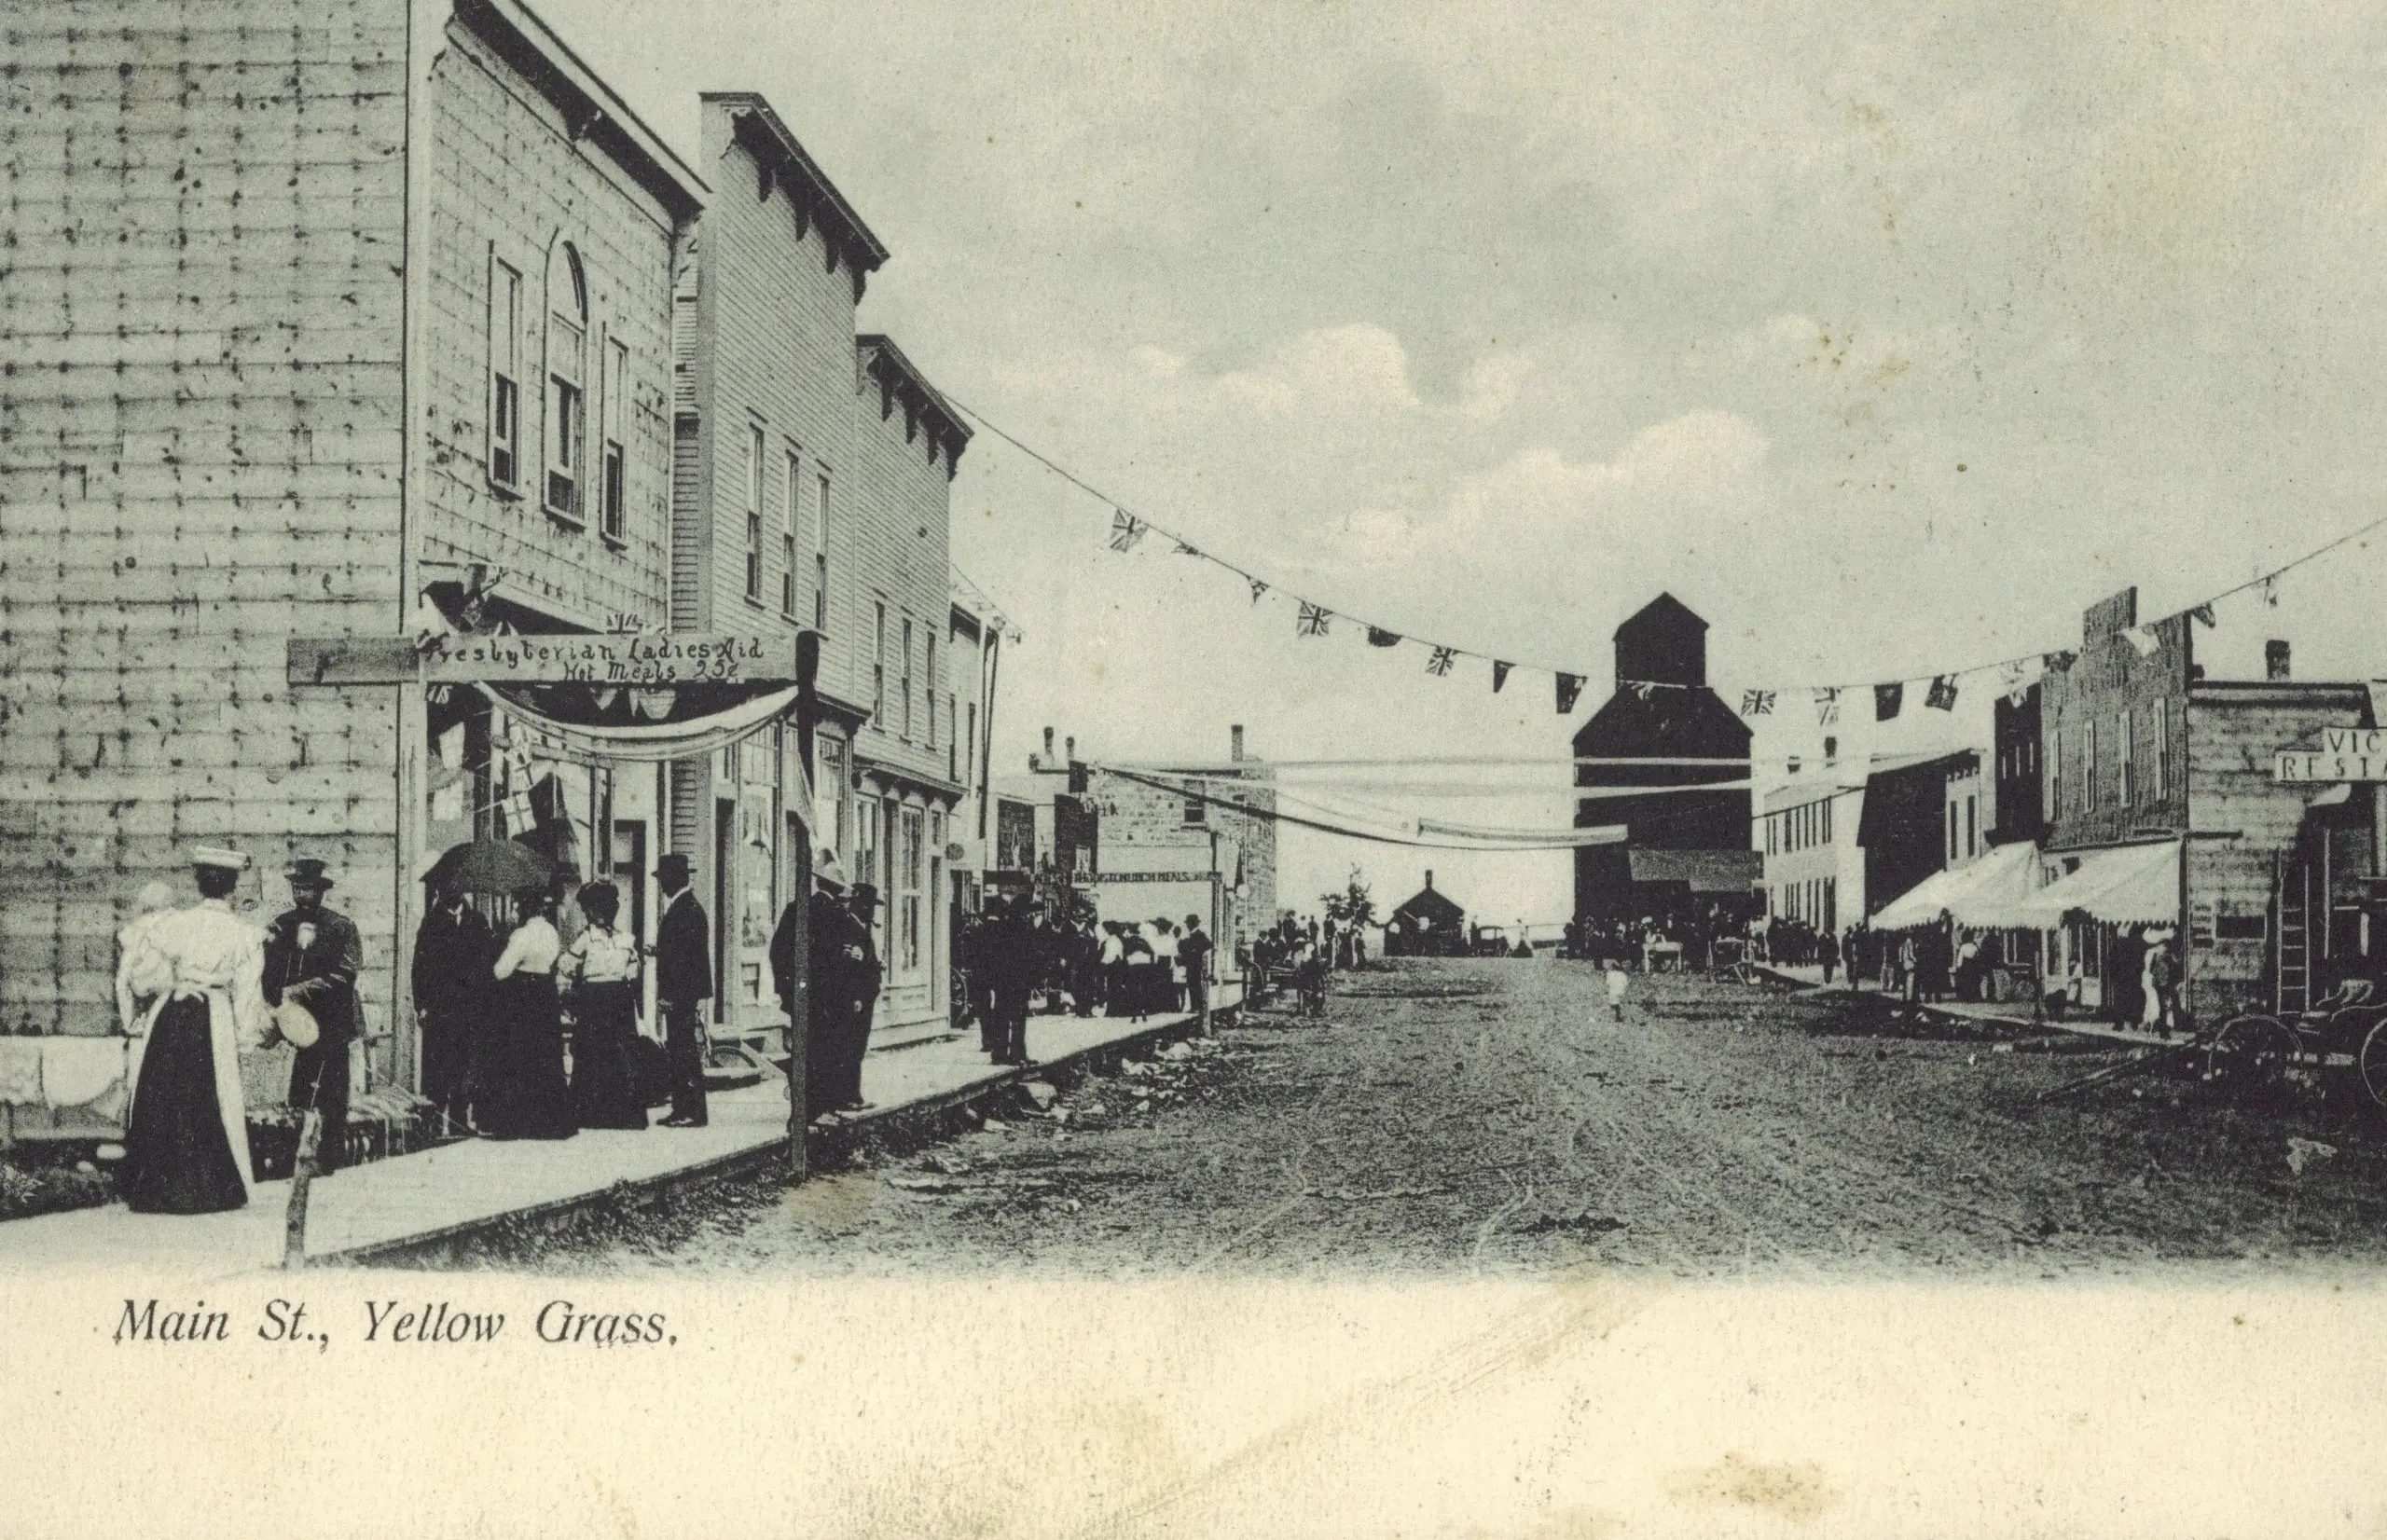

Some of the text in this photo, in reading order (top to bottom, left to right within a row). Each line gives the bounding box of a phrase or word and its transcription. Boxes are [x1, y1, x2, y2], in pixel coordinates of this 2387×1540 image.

[628, 638, 711, 664] Ladies
[716, 637, 764, 663] Aid
[564, 661, 596, 681] Hot
[607, 659, 677, 681] Meals
